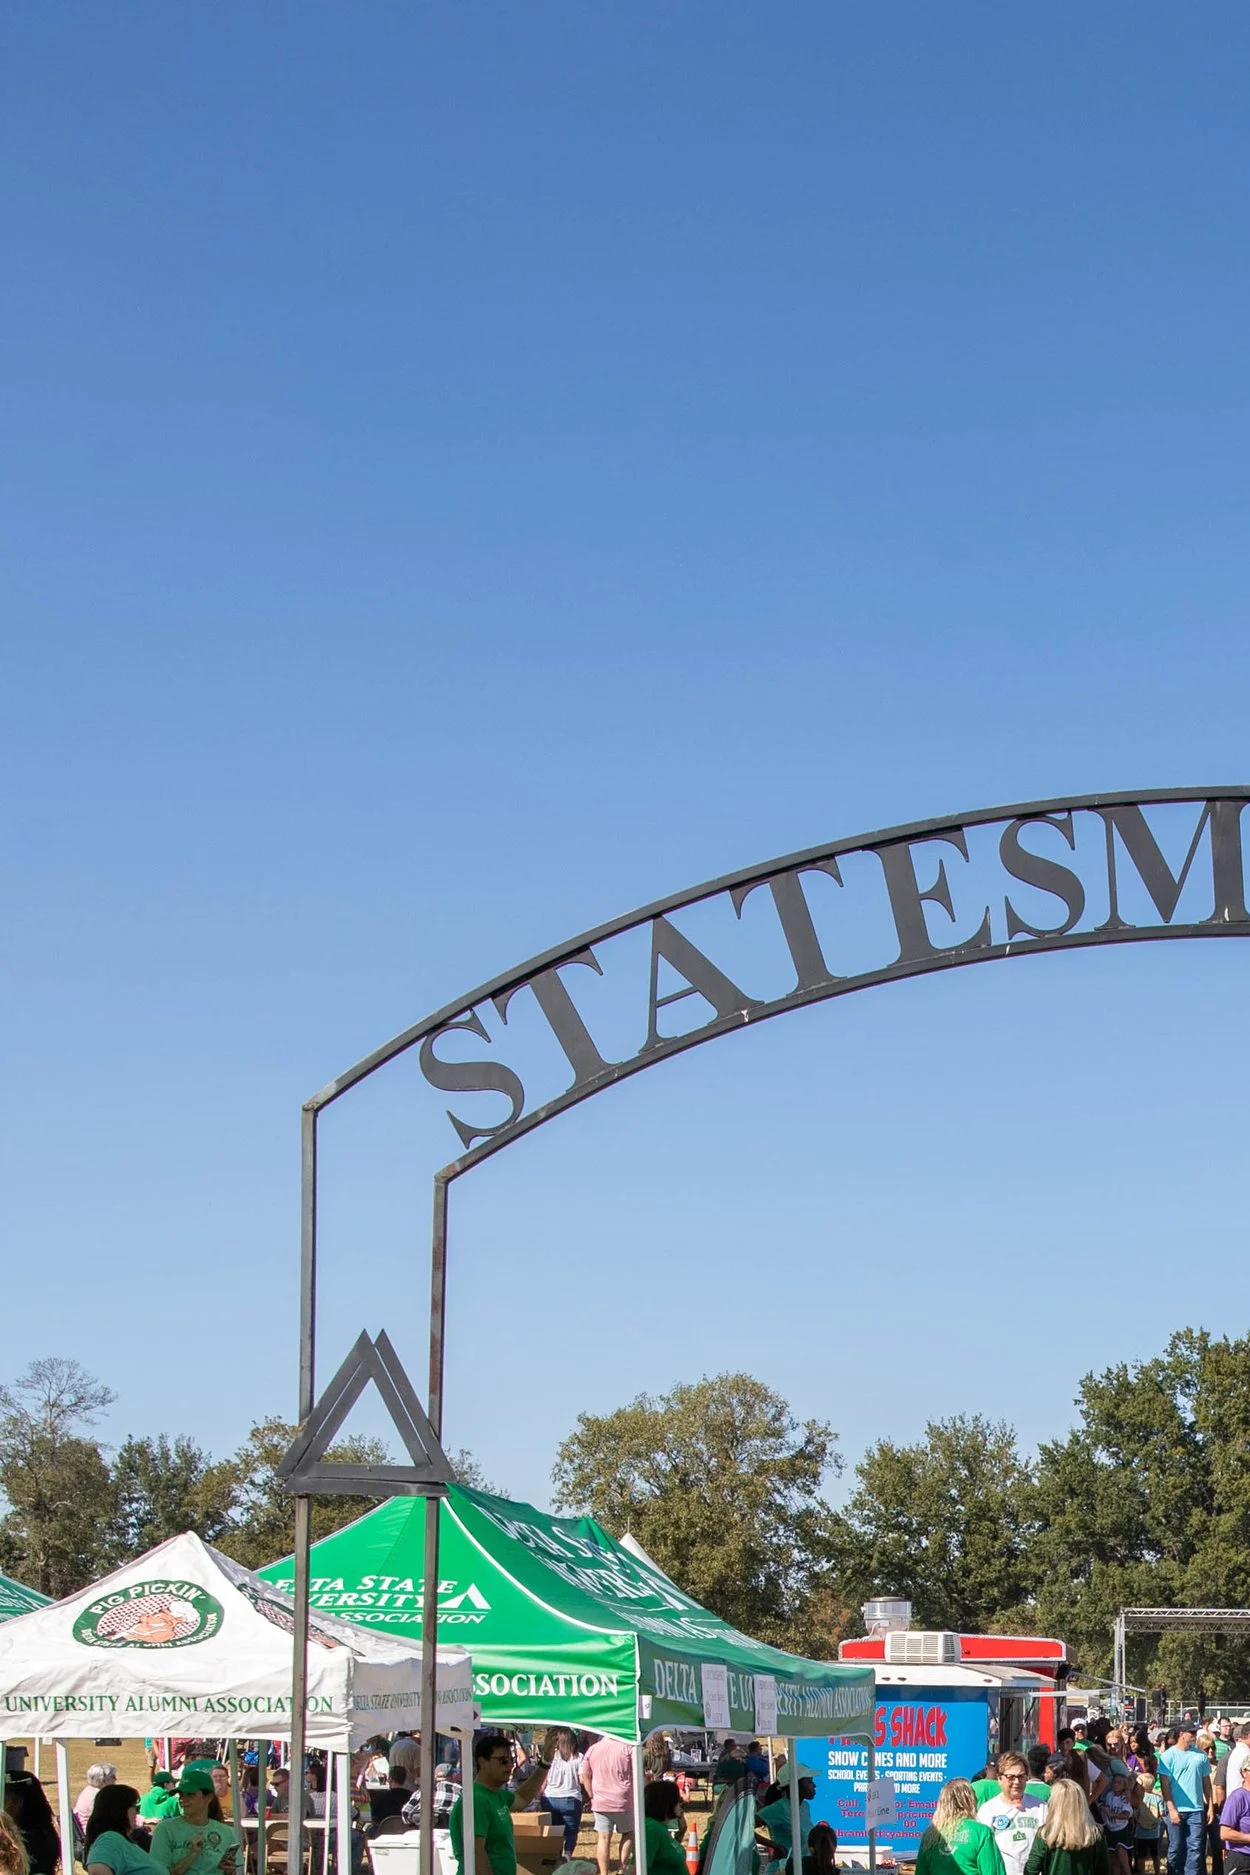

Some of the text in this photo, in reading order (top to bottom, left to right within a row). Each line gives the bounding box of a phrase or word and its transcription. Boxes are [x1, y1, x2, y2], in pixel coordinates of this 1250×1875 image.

[90, 1582, 207, 1615] PIG PICKIN'
[654, 1659, 699, 1705] DELTA
[5, 1695, 334, 1714] UNIVERSITY ALUMNI ASSOCIATON
[890, 1705, 948, 1748] SHACK
[828, 1751, 948, 1768] SNOW CNES AND MORE
[828, 1769, 855, 1780] SCHOOL
[856, 1770, 880, 1780] EVES
[919, 1772, 943, 1782] EVENTS
[901, 1783, 921, 1794] MORE
